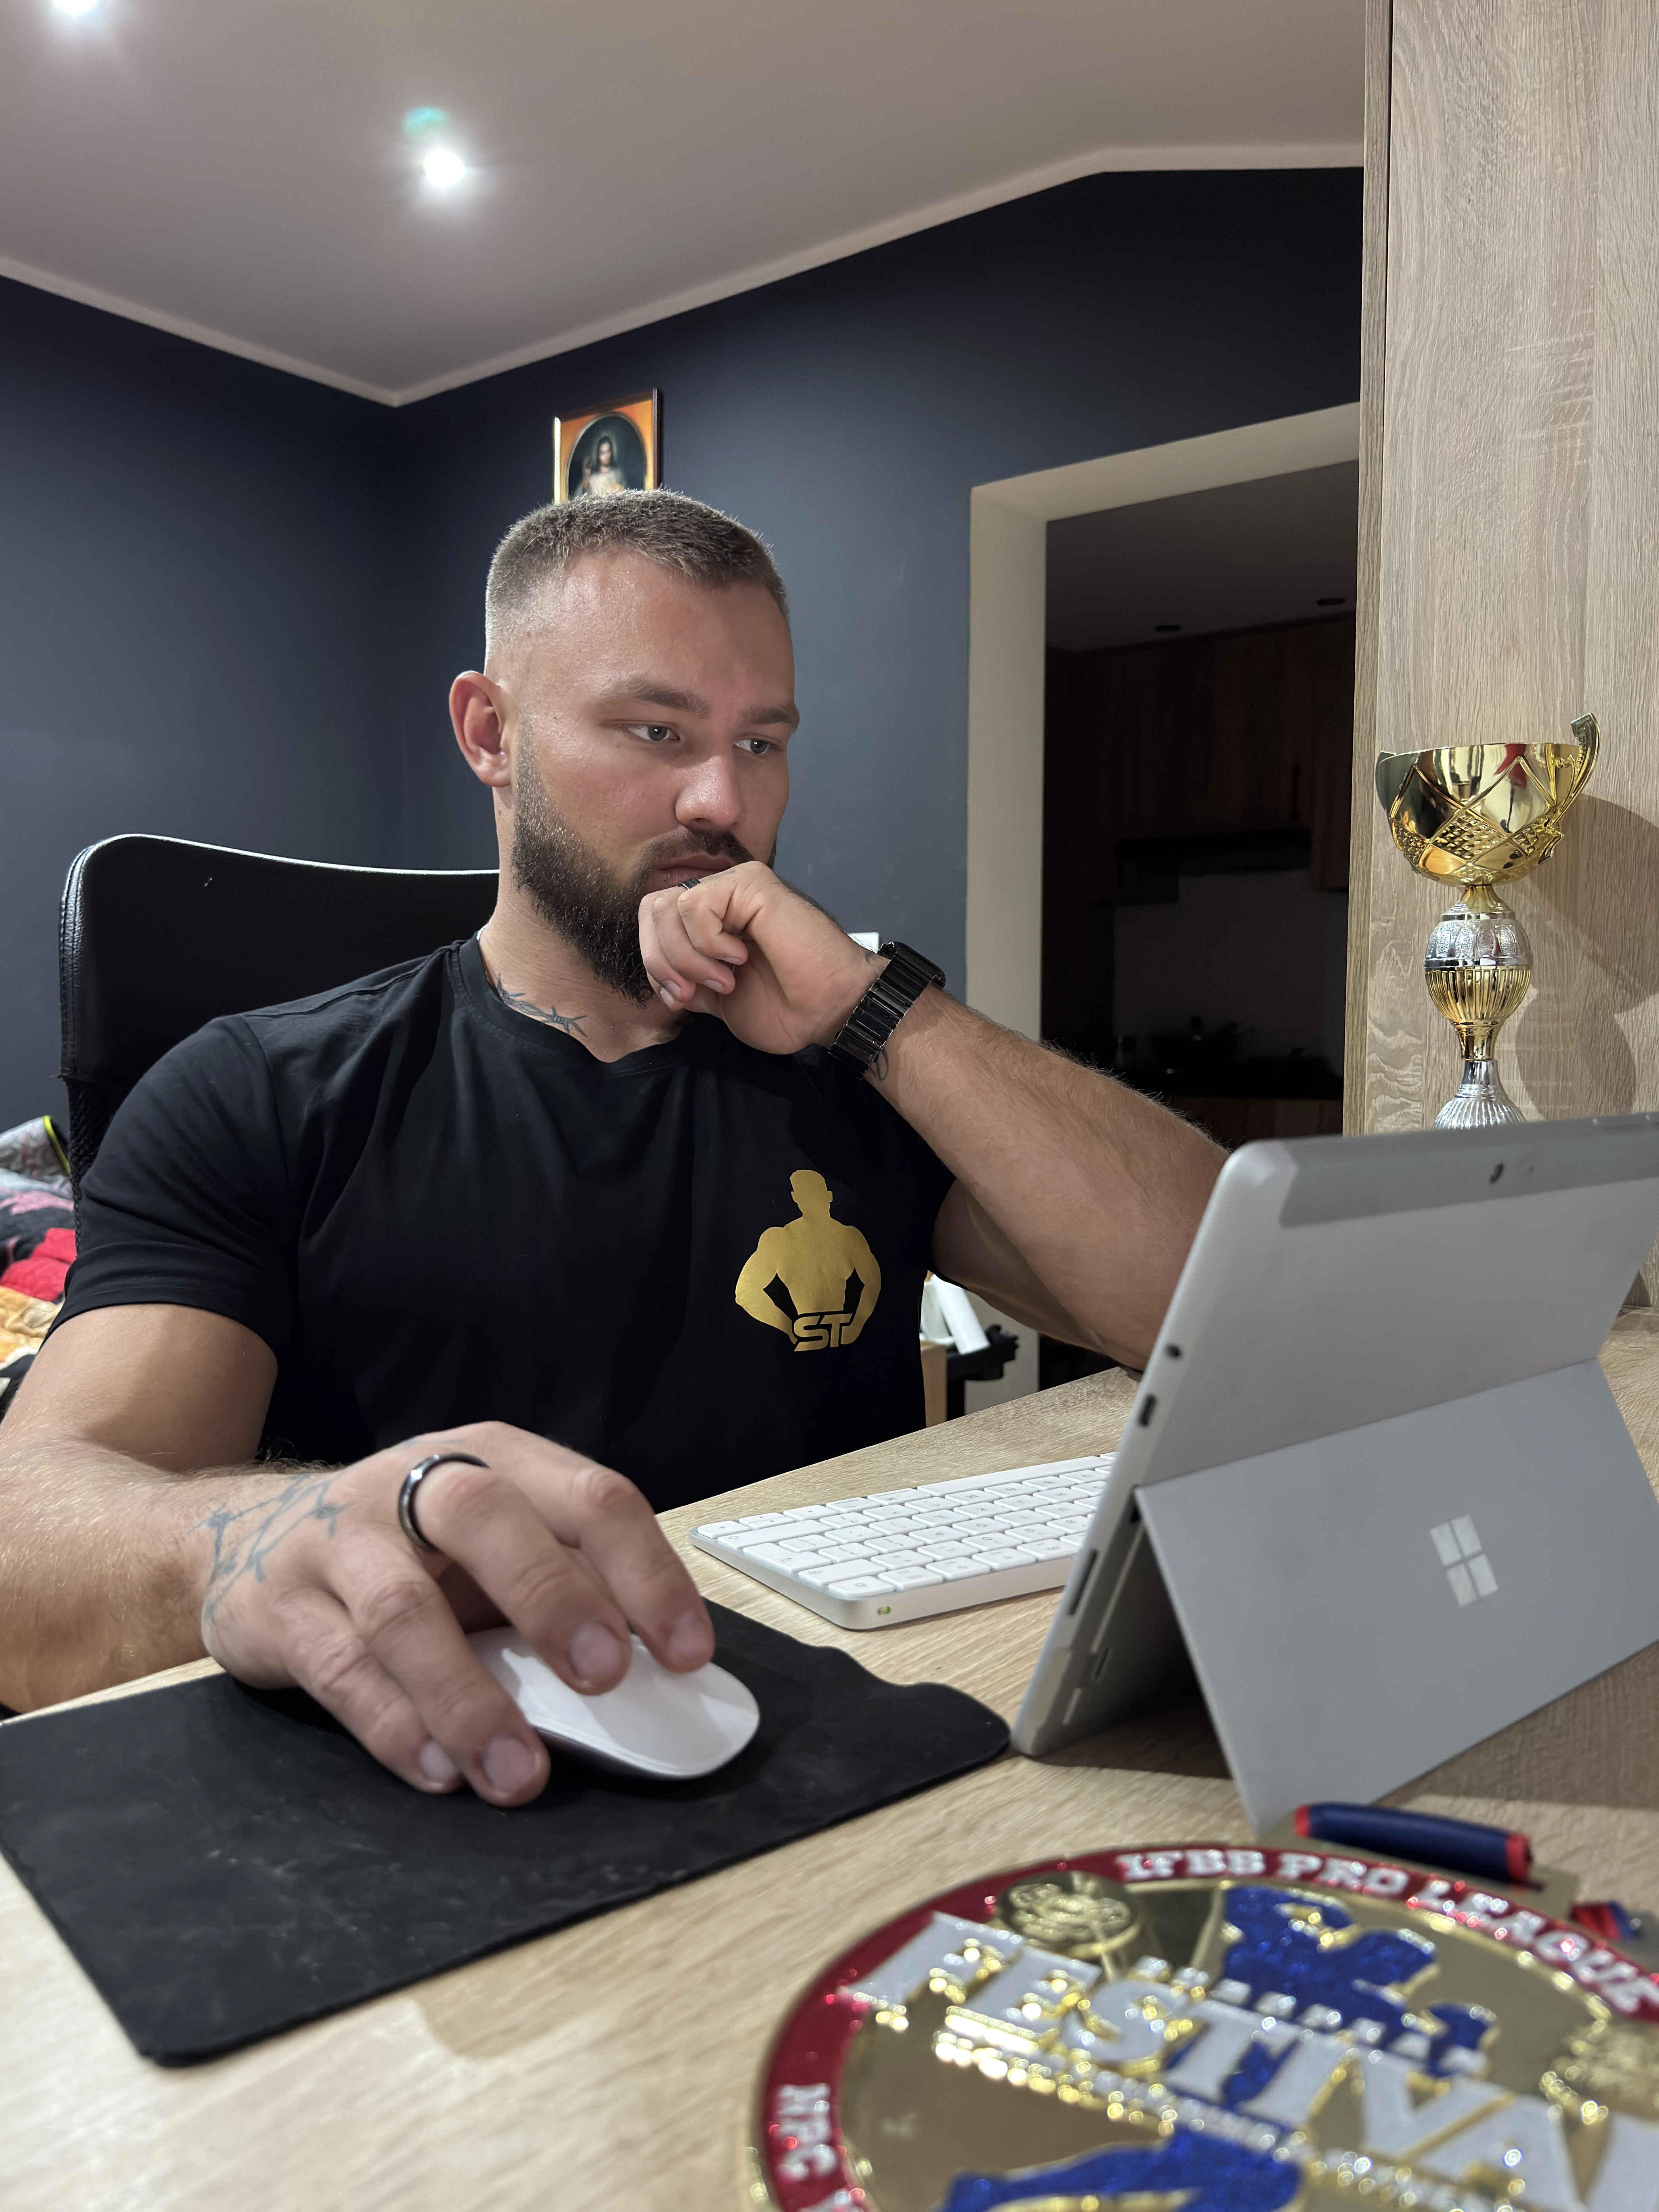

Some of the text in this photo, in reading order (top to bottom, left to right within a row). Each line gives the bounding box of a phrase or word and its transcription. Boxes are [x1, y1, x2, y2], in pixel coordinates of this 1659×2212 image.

[794, 1313, 853, 1352] ST
[1116, 1849, 1265, 1881] IFBB
[1277, 1852, 1409, 1895] PRO
